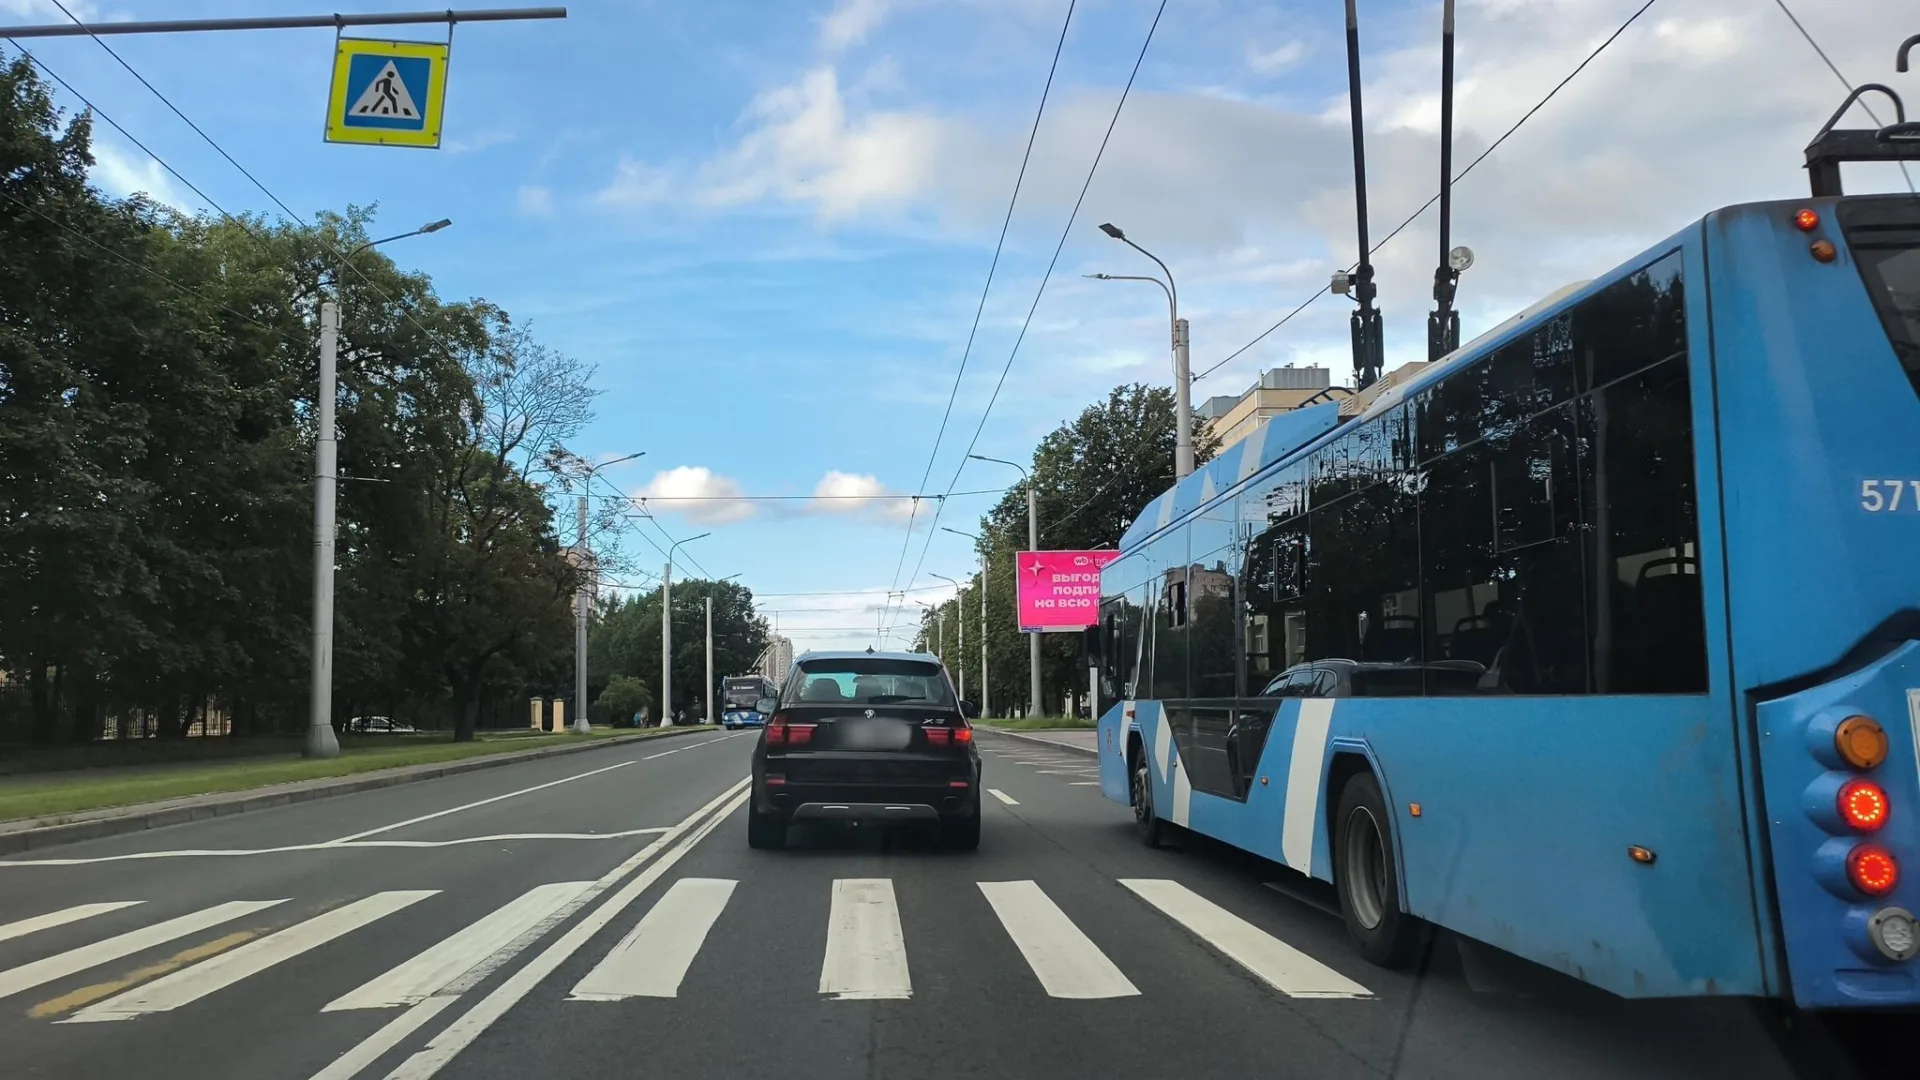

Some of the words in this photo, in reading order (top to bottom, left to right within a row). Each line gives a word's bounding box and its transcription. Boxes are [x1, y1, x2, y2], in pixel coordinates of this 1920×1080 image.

[1075, 556, 1088, 565] wb
[1034, 599, 1055, 608] на
[1058, 598, 1090, 608] всю
